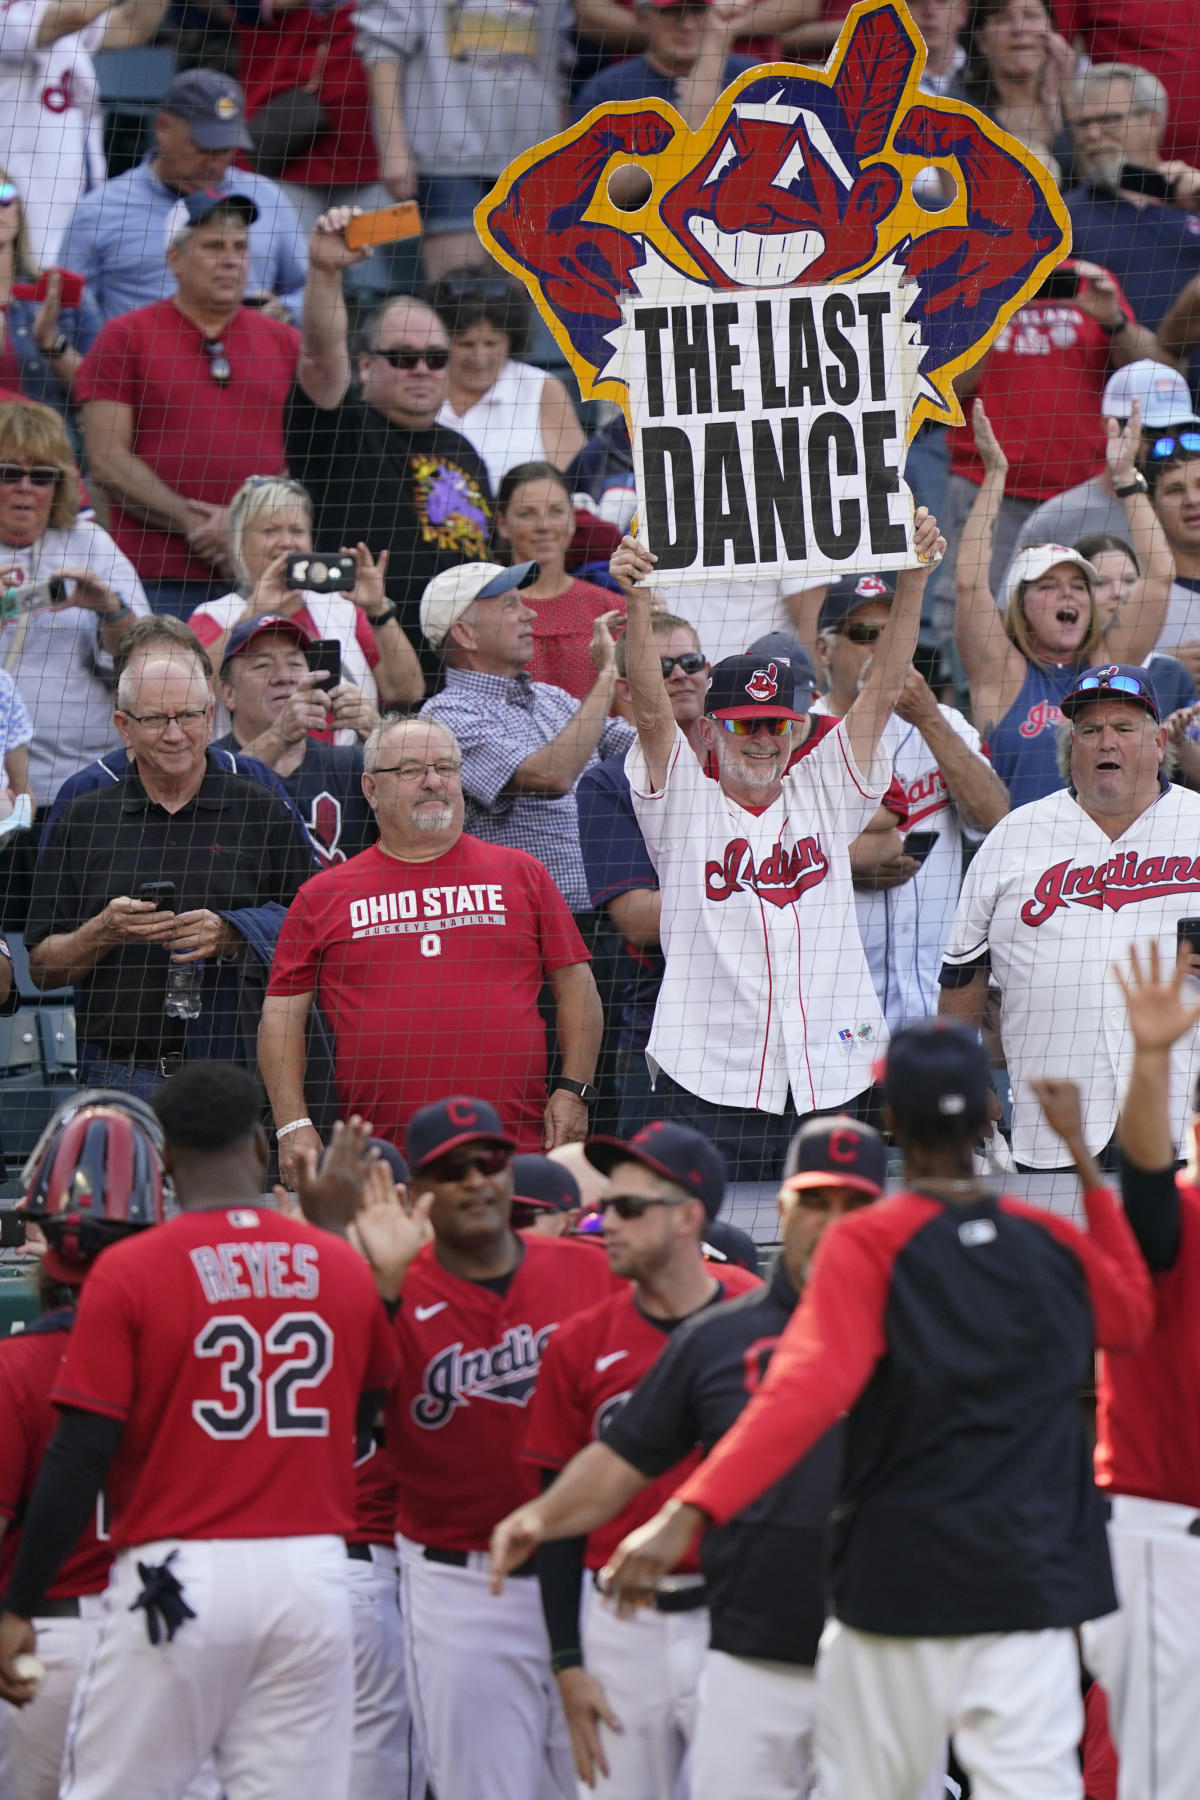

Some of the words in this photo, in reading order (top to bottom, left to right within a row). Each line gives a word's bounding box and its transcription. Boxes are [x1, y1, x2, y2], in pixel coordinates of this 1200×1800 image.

[634, 302, 745, 417] THE
[756, 292, 891, 409] LAST
[641, 410, 908, 570] DANCE
[350, 890, 418, 928] OHIO
[422, 884, 506, 917] STATE
[364, 922, 430, 936] BUCKEYE
[440, 916, 495, 929] NATION
[421, 933, 441, 957] O
[447, 1097, 478, 1127] C
[828, 1129, 860, 1163] C
[189, 1242, 320, 1303] REYES
[192, 1311, 334, 1440] 32
